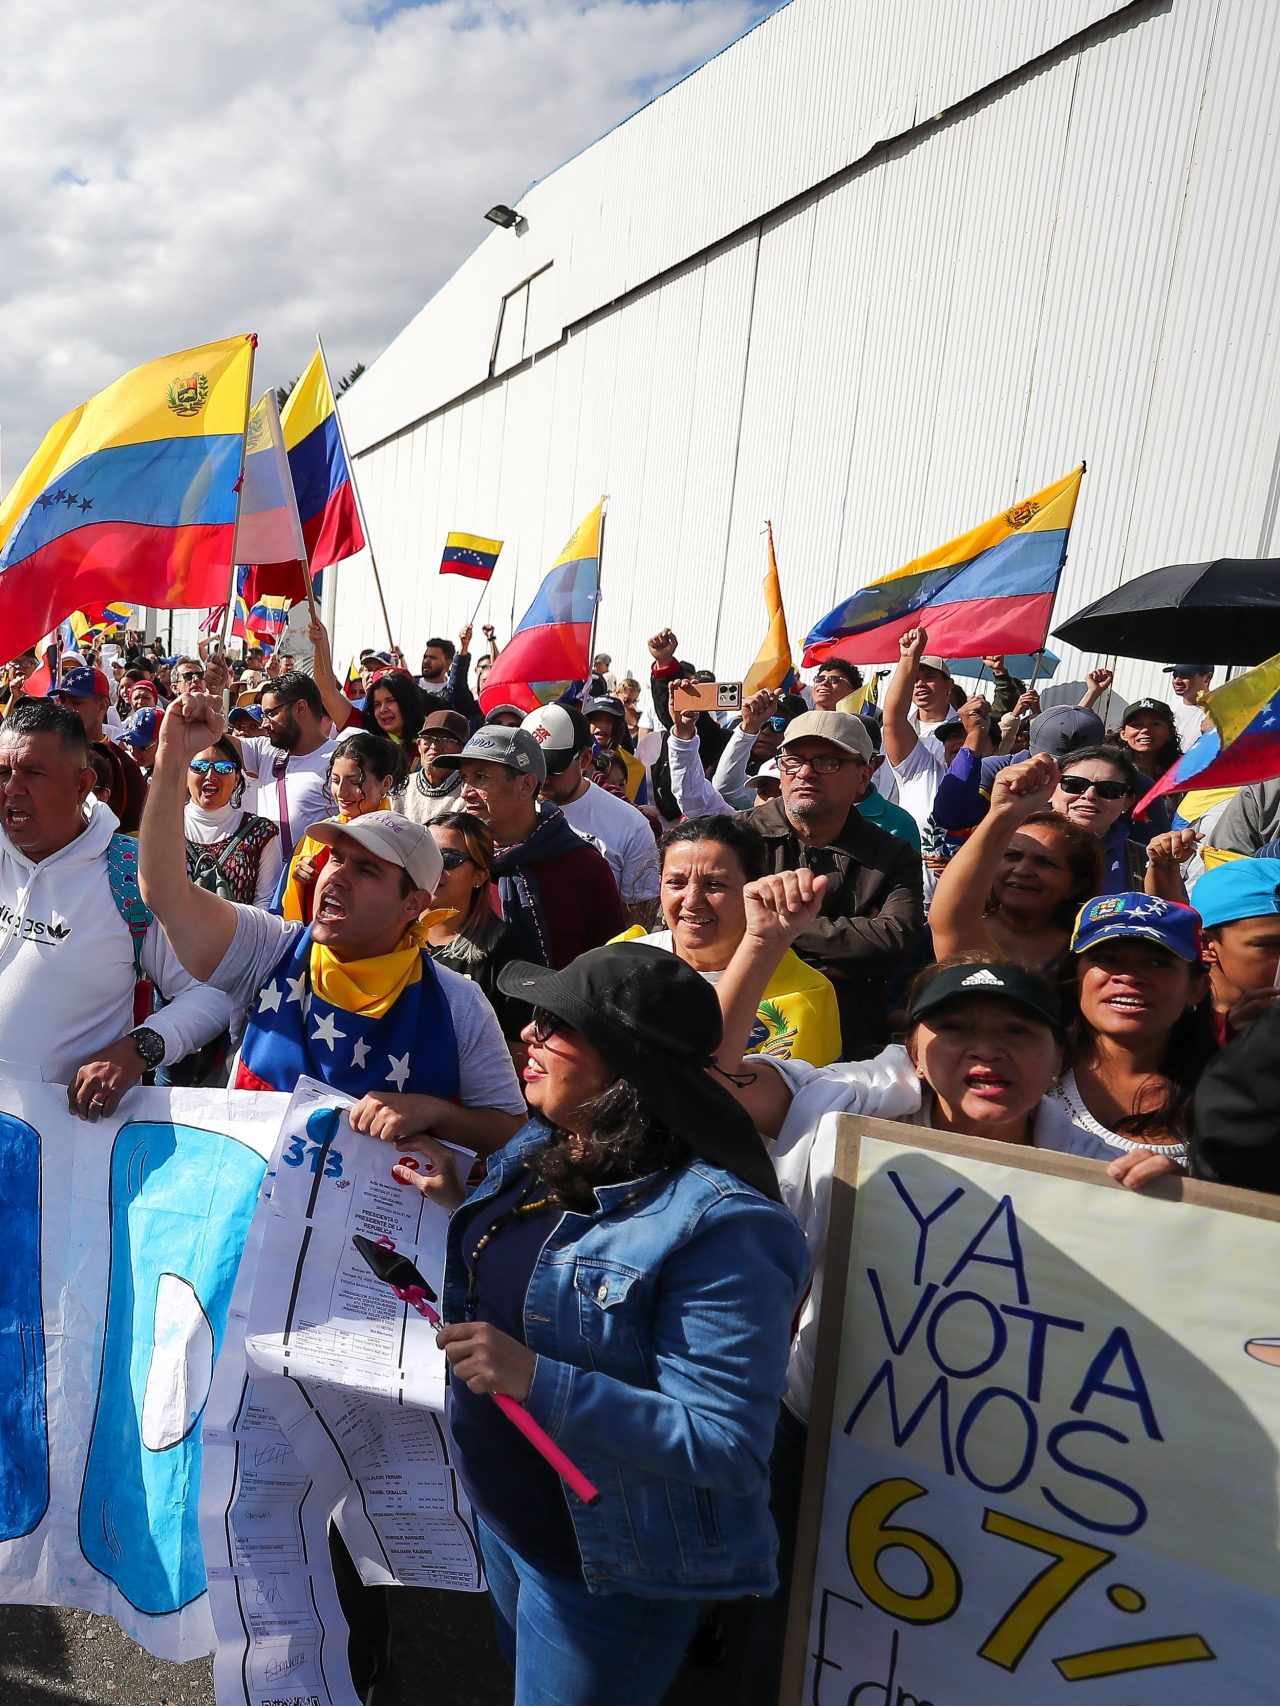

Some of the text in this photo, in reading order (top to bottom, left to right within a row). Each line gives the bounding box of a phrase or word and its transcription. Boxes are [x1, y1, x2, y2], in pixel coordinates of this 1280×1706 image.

[282, 1135, 343, 1179] 313
[887, 1170, 1030, 1305] YA
[866, 1268, 1165, 1442] VOTA
[843, 1359, 1148, 1536] MOS
